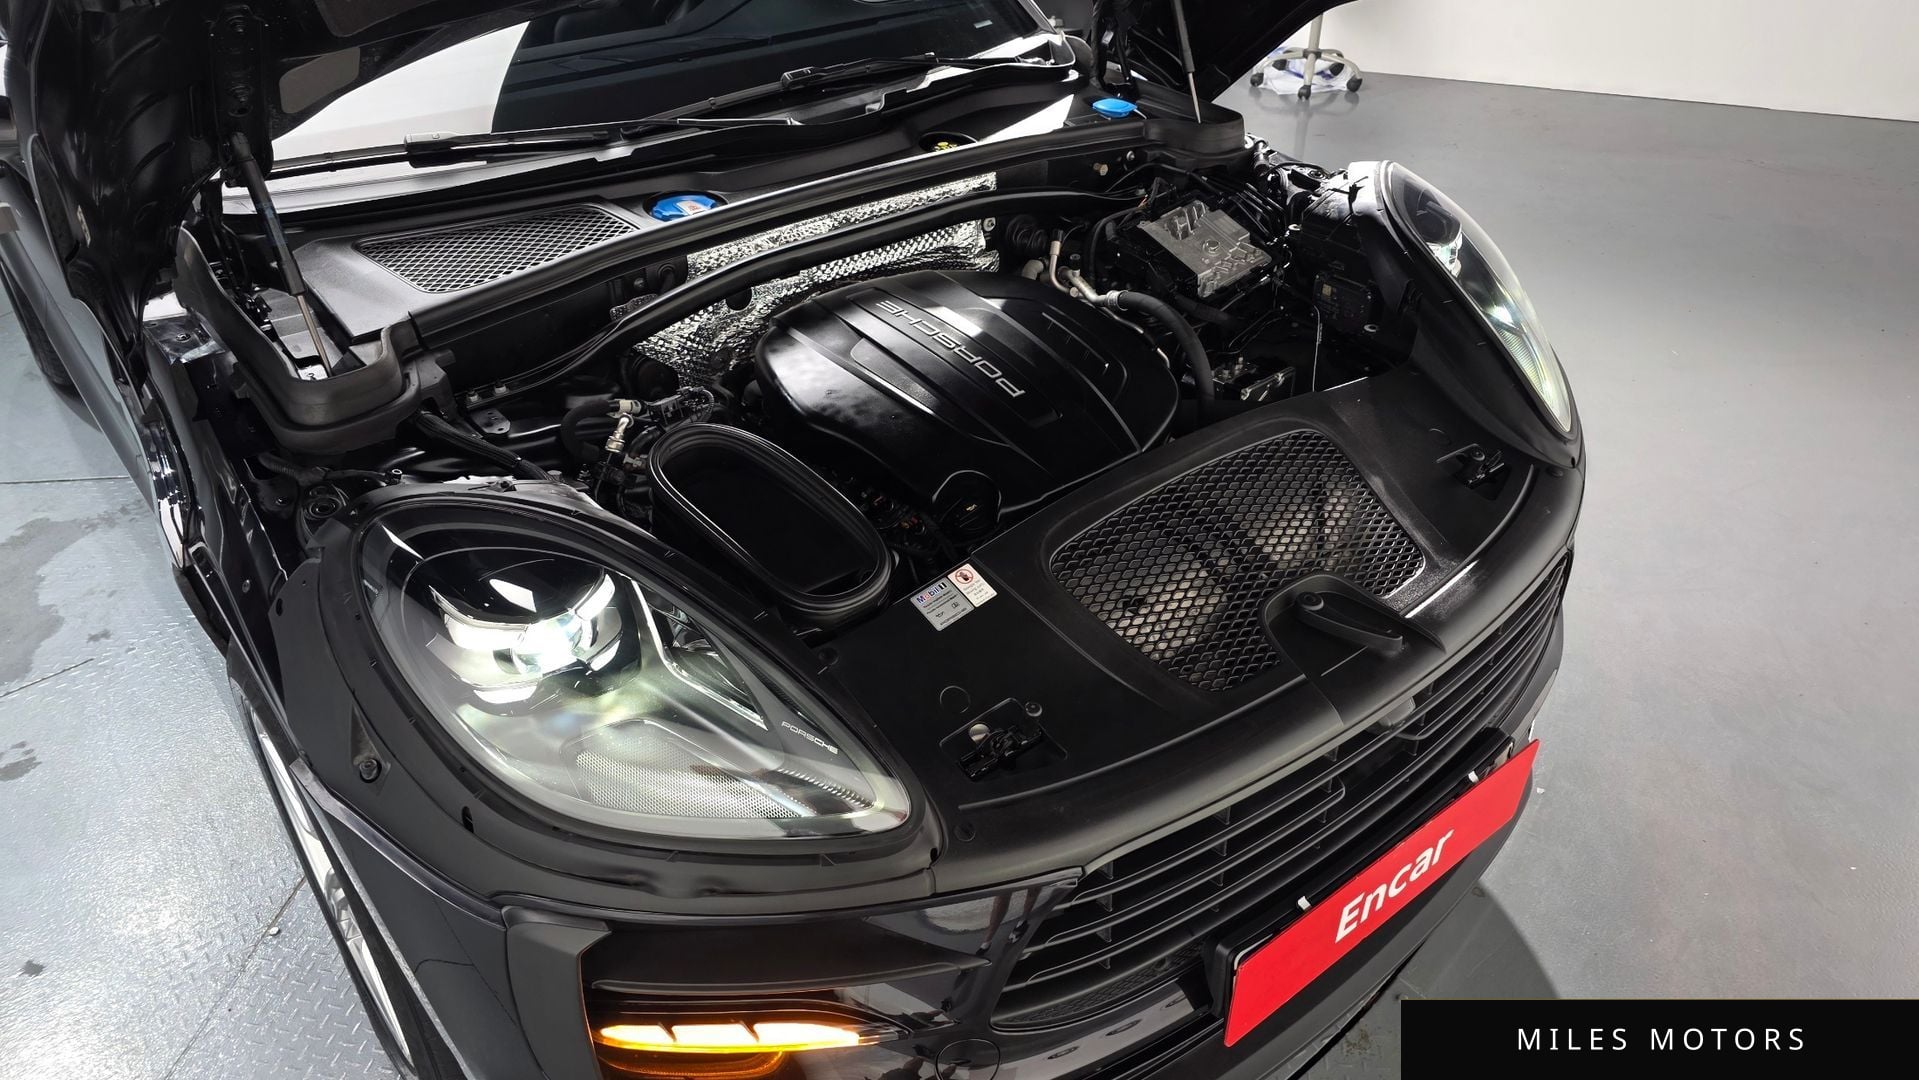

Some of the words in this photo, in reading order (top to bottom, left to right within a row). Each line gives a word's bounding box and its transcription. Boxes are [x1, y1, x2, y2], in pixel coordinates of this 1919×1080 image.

[876, 300, 1025, 397] PORSCHE
[916, 586, 940, 604] Mobil
[781, 721, 838, 755] PORSCHE
[1335, 829, 1454, 944] Encar
